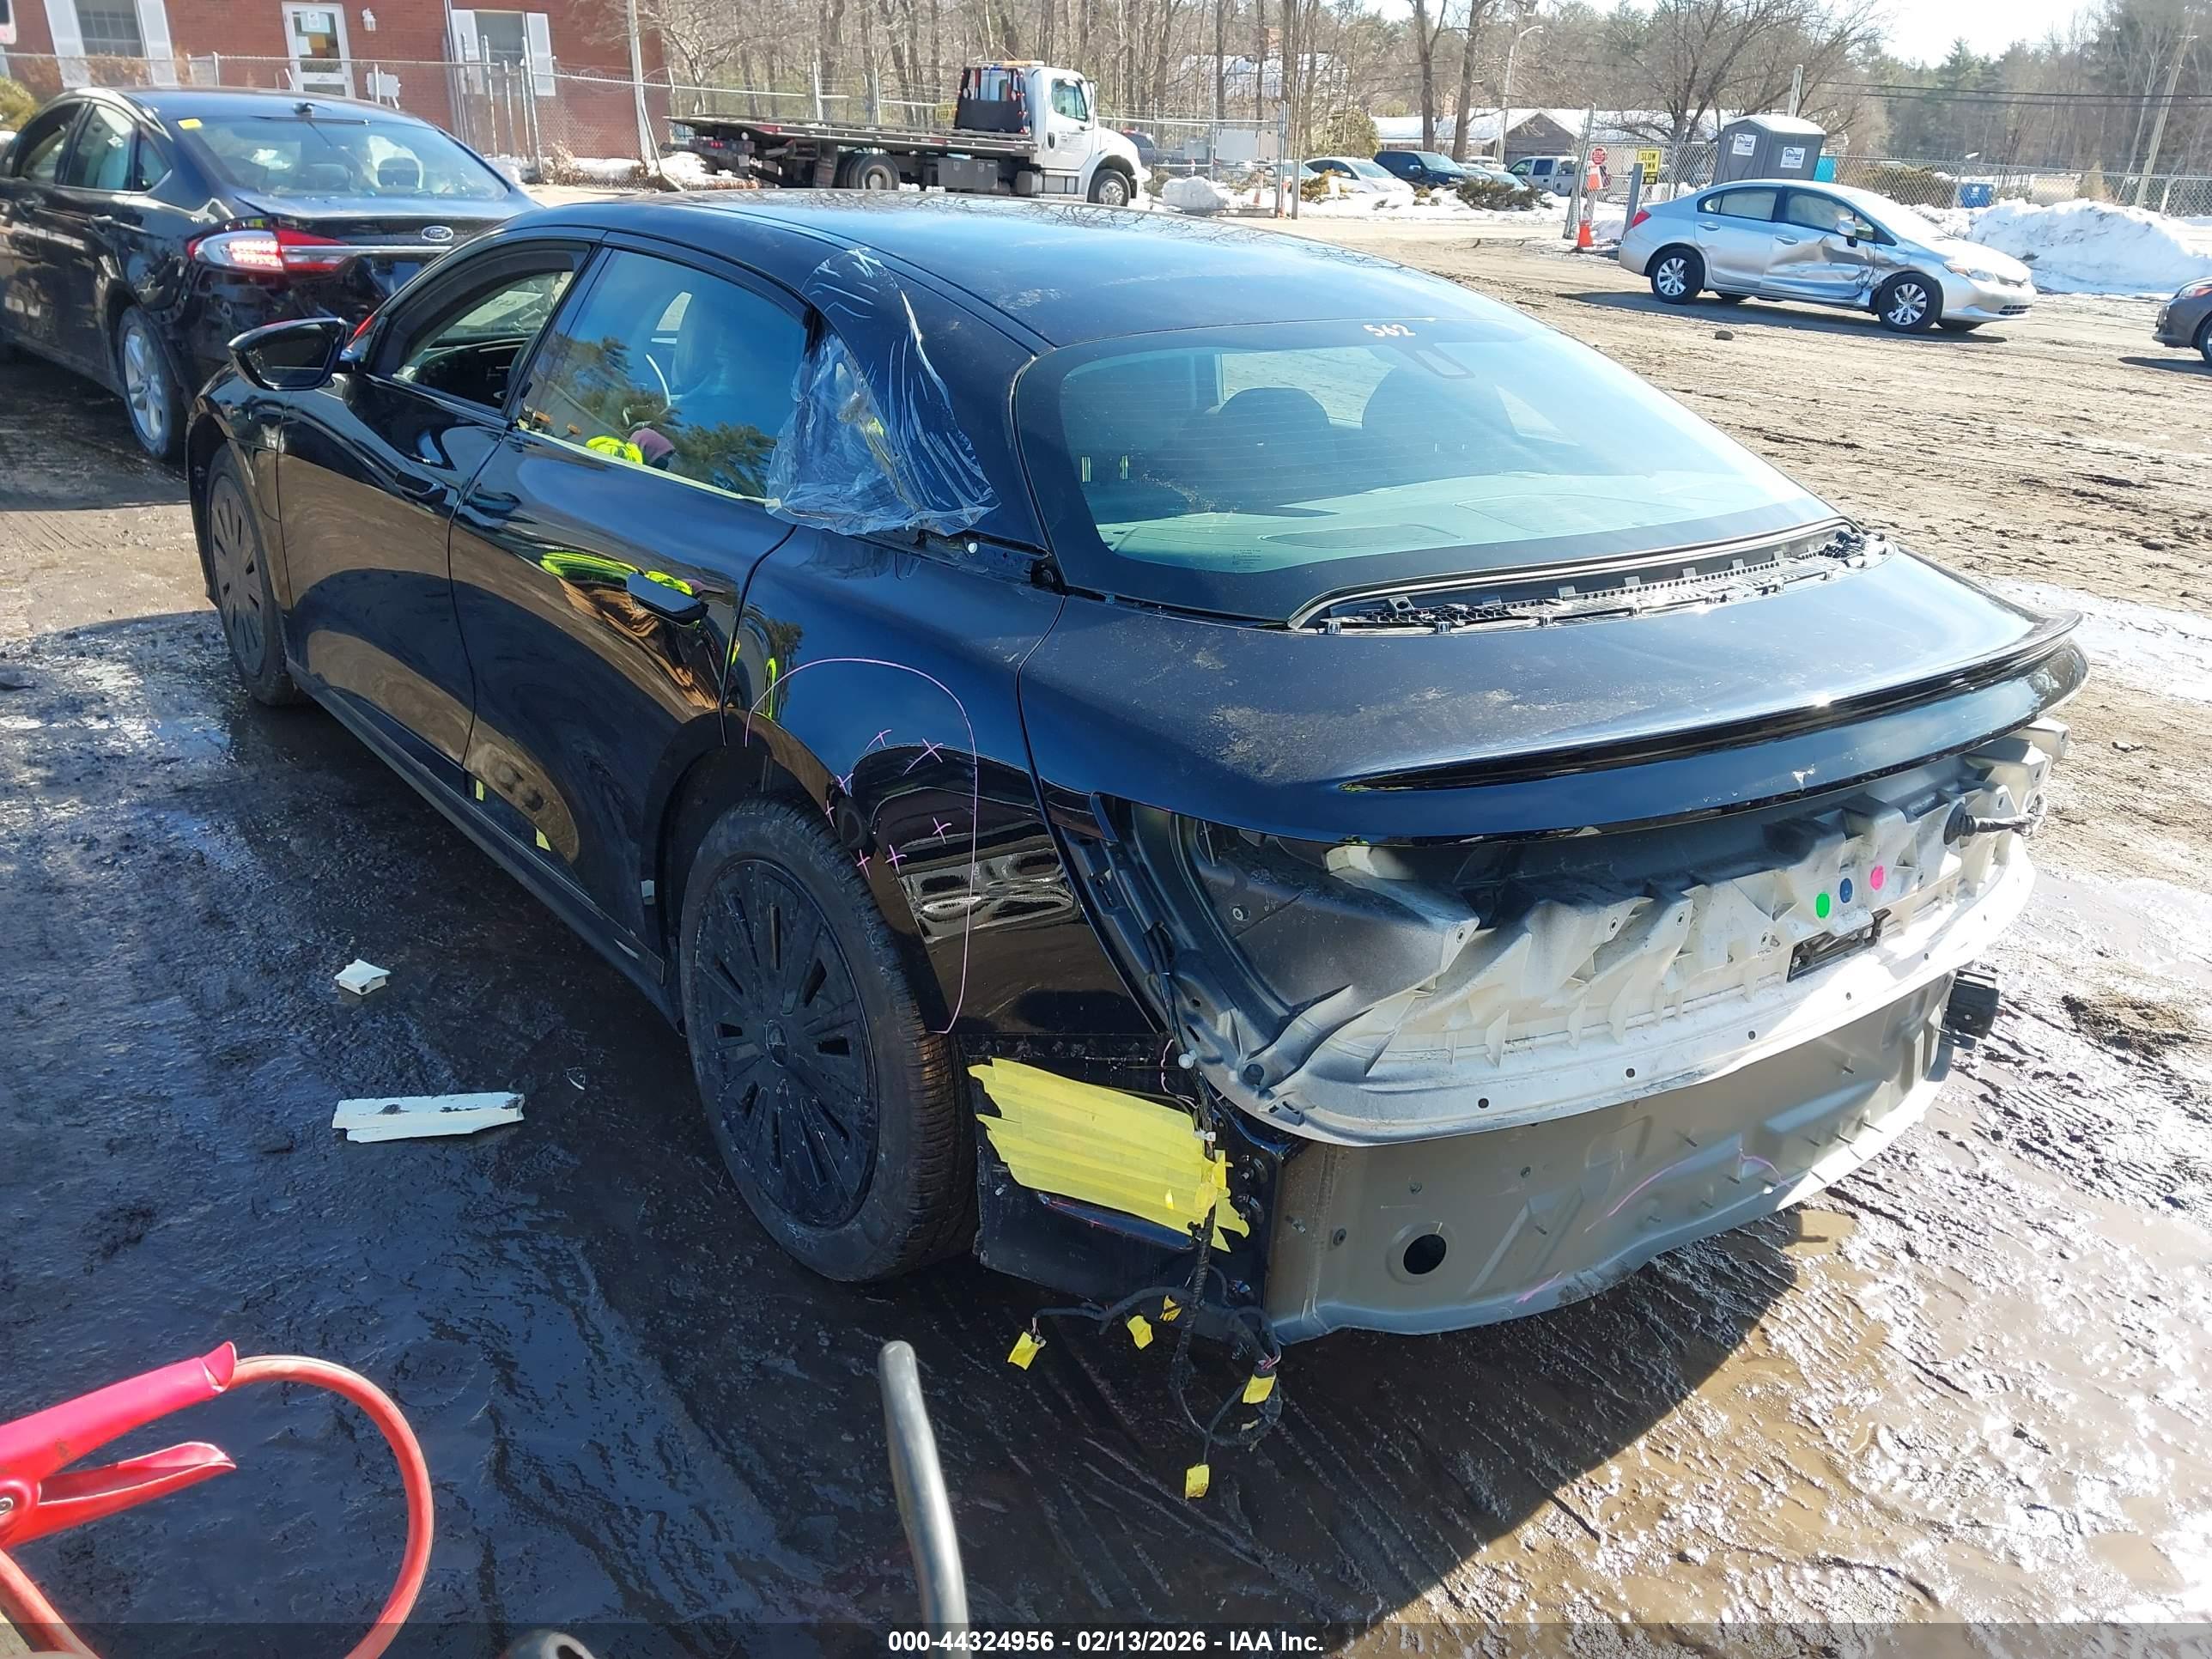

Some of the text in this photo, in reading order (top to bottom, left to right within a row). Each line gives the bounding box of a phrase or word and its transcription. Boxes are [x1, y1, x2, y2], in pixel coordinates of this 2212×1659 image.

[1641, 152, 1657, 161] SLOW
[1644, 161, 1656, 170] OWN
[1363, 324, 1416, 337] 562
